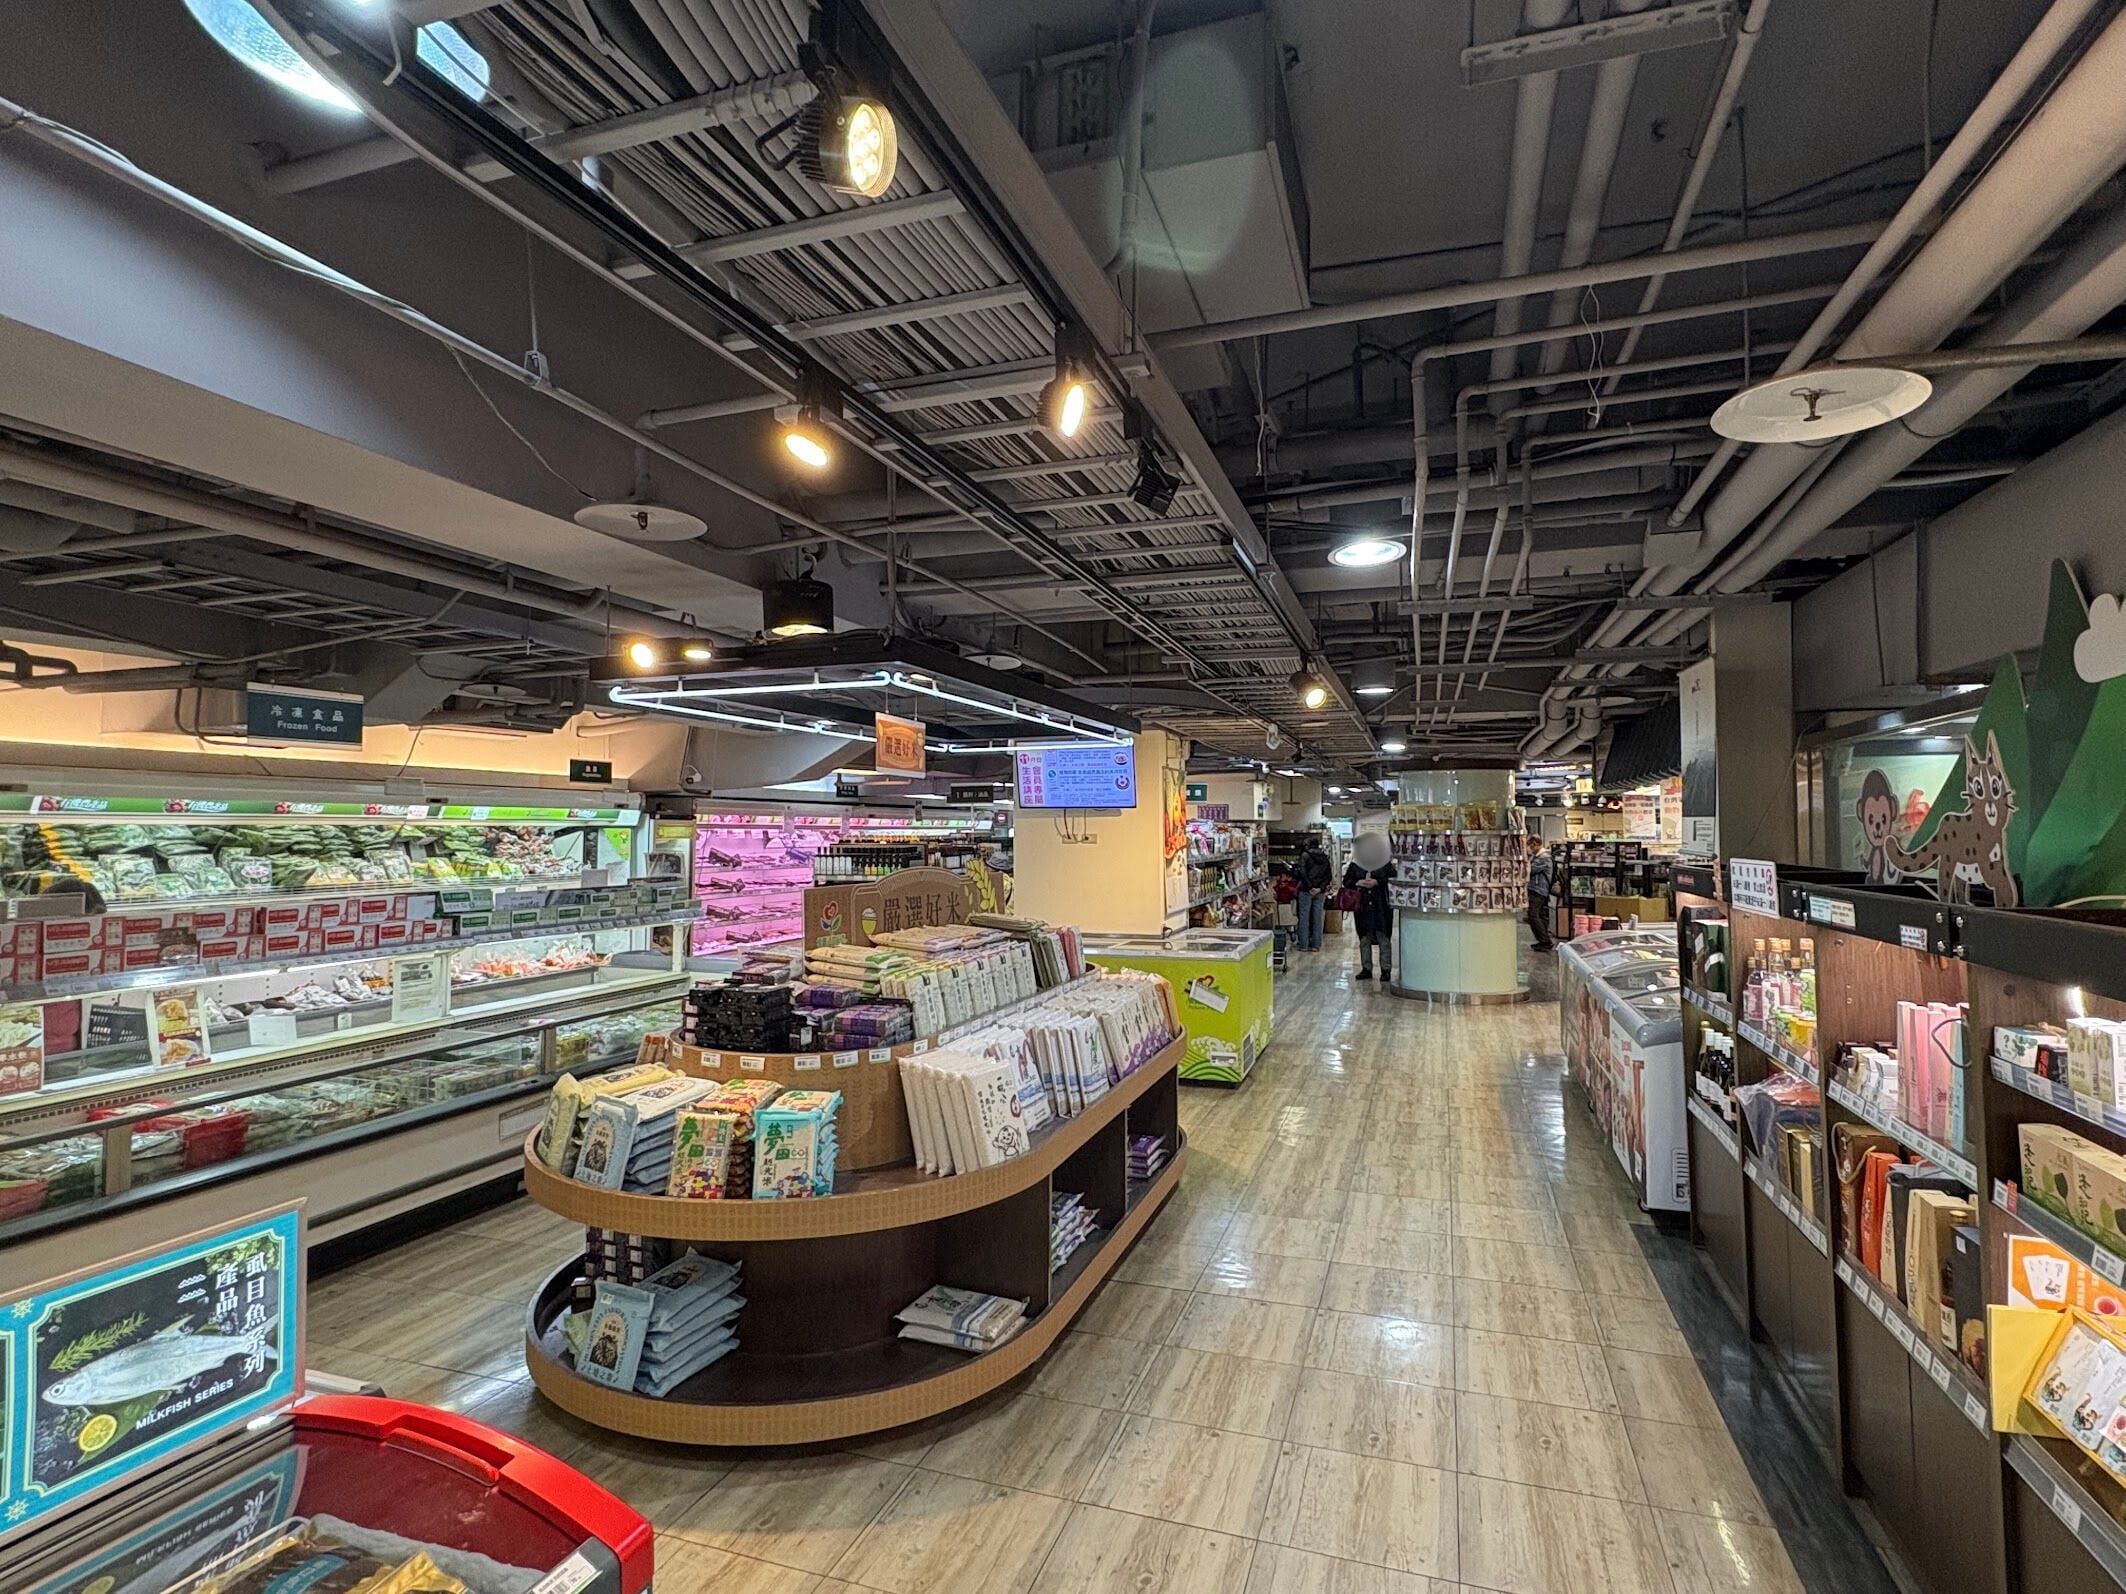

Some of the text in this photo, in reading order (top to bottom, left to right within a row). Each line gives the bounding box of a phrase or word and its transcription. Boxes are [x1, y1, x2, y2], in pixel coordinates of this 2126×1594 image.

[270, 704, 344, 722] 冷凍食品
[277, 720, 338, 733] Frozen Food
[885, 736, 921, 759] 嚴選好米
[883, 891, 961, 931] 嚴選好米
[763, 1122, 791, 1161] 夢田
[216, 1261, 239, 1315] 產品
[244, 1251, 267, 1379] 虱目魚系列
[136, 1378, 234, 1430] MILKFISH SERIES
